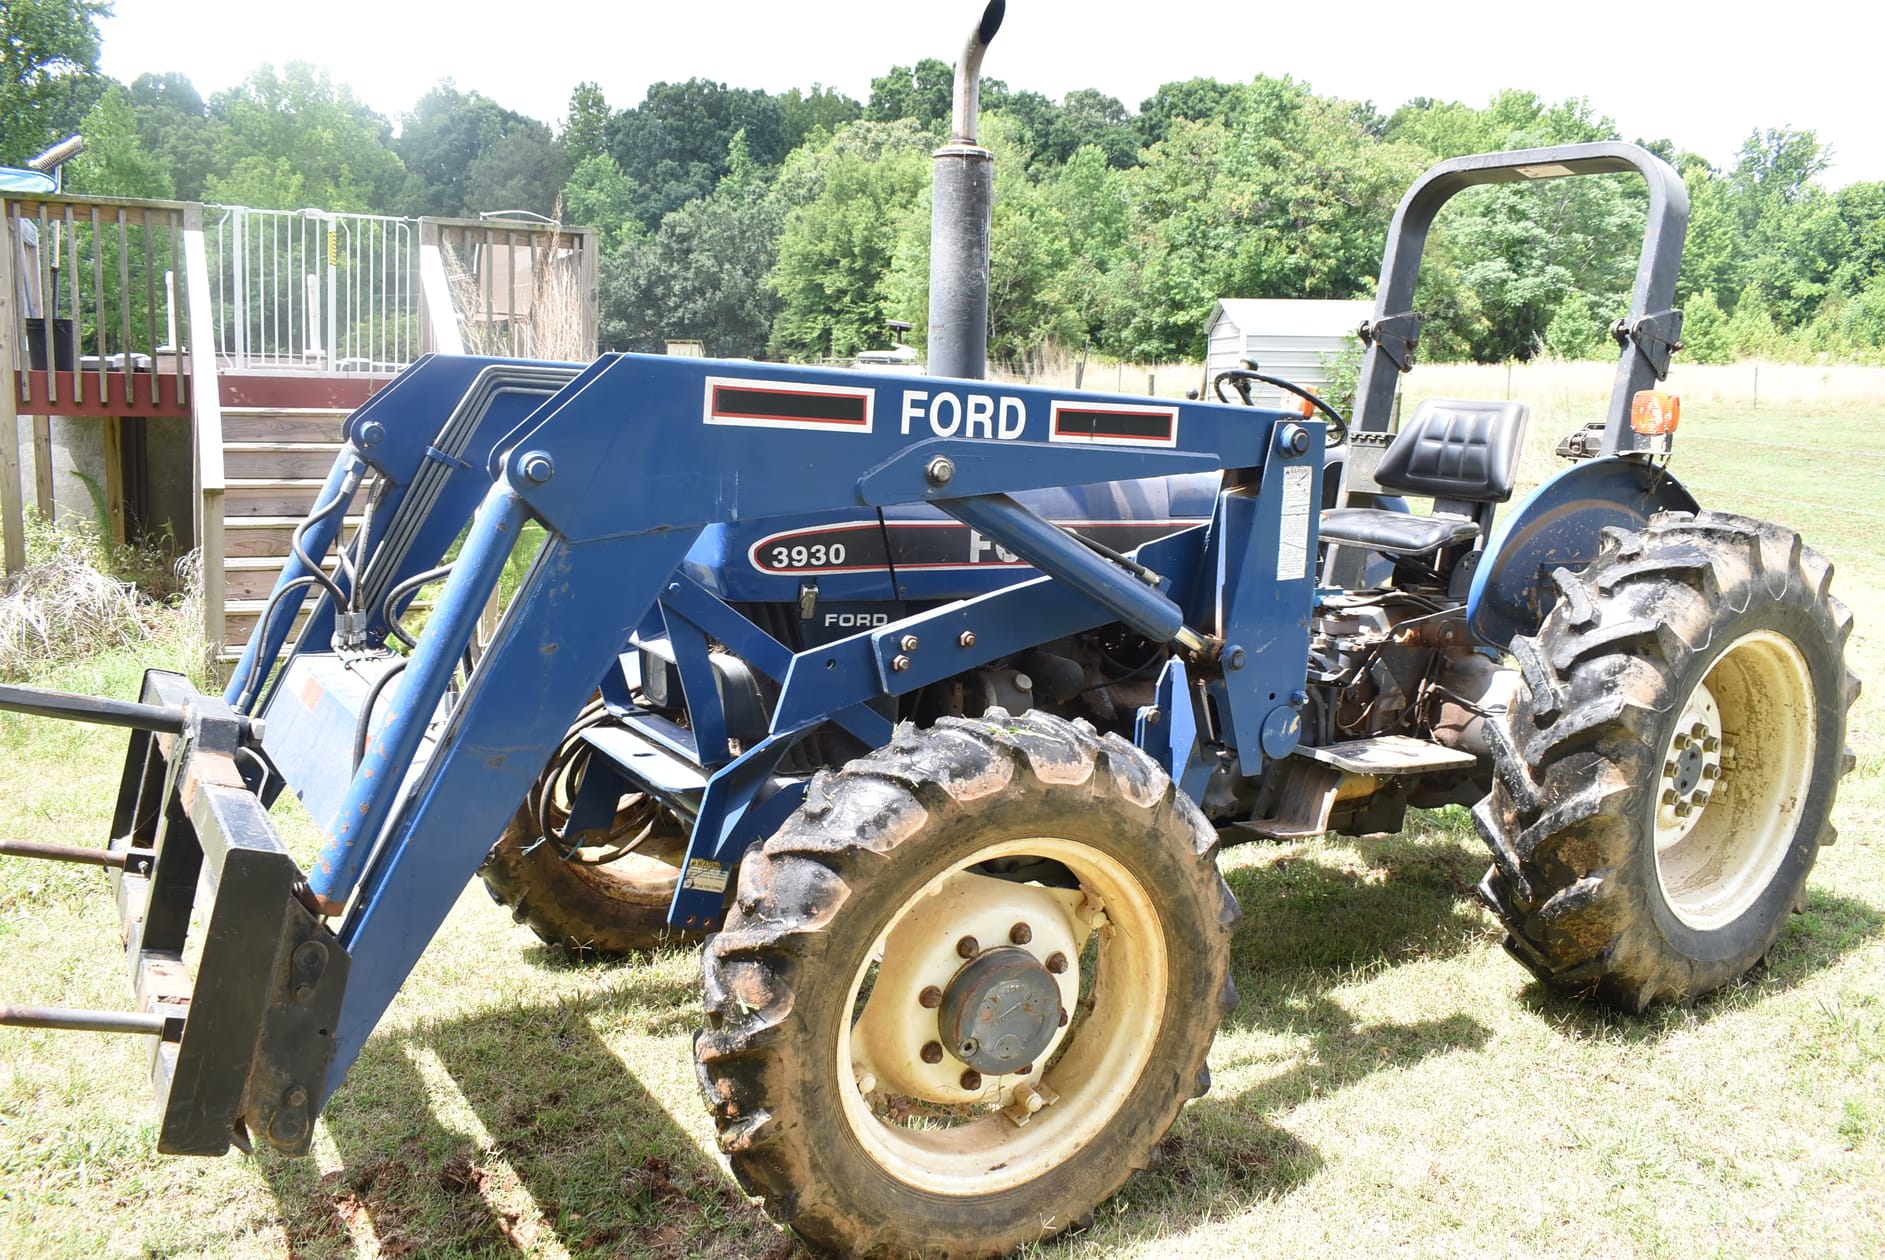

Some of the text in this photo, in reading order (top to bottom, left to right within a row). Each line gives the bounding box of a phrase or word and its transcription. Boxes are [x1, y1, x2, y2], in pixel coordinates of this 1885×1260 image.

[901, 390, 1026, 440] FORD
[772, 543, 846, 568] 3930
[824, 613, 888, 627] FORD
